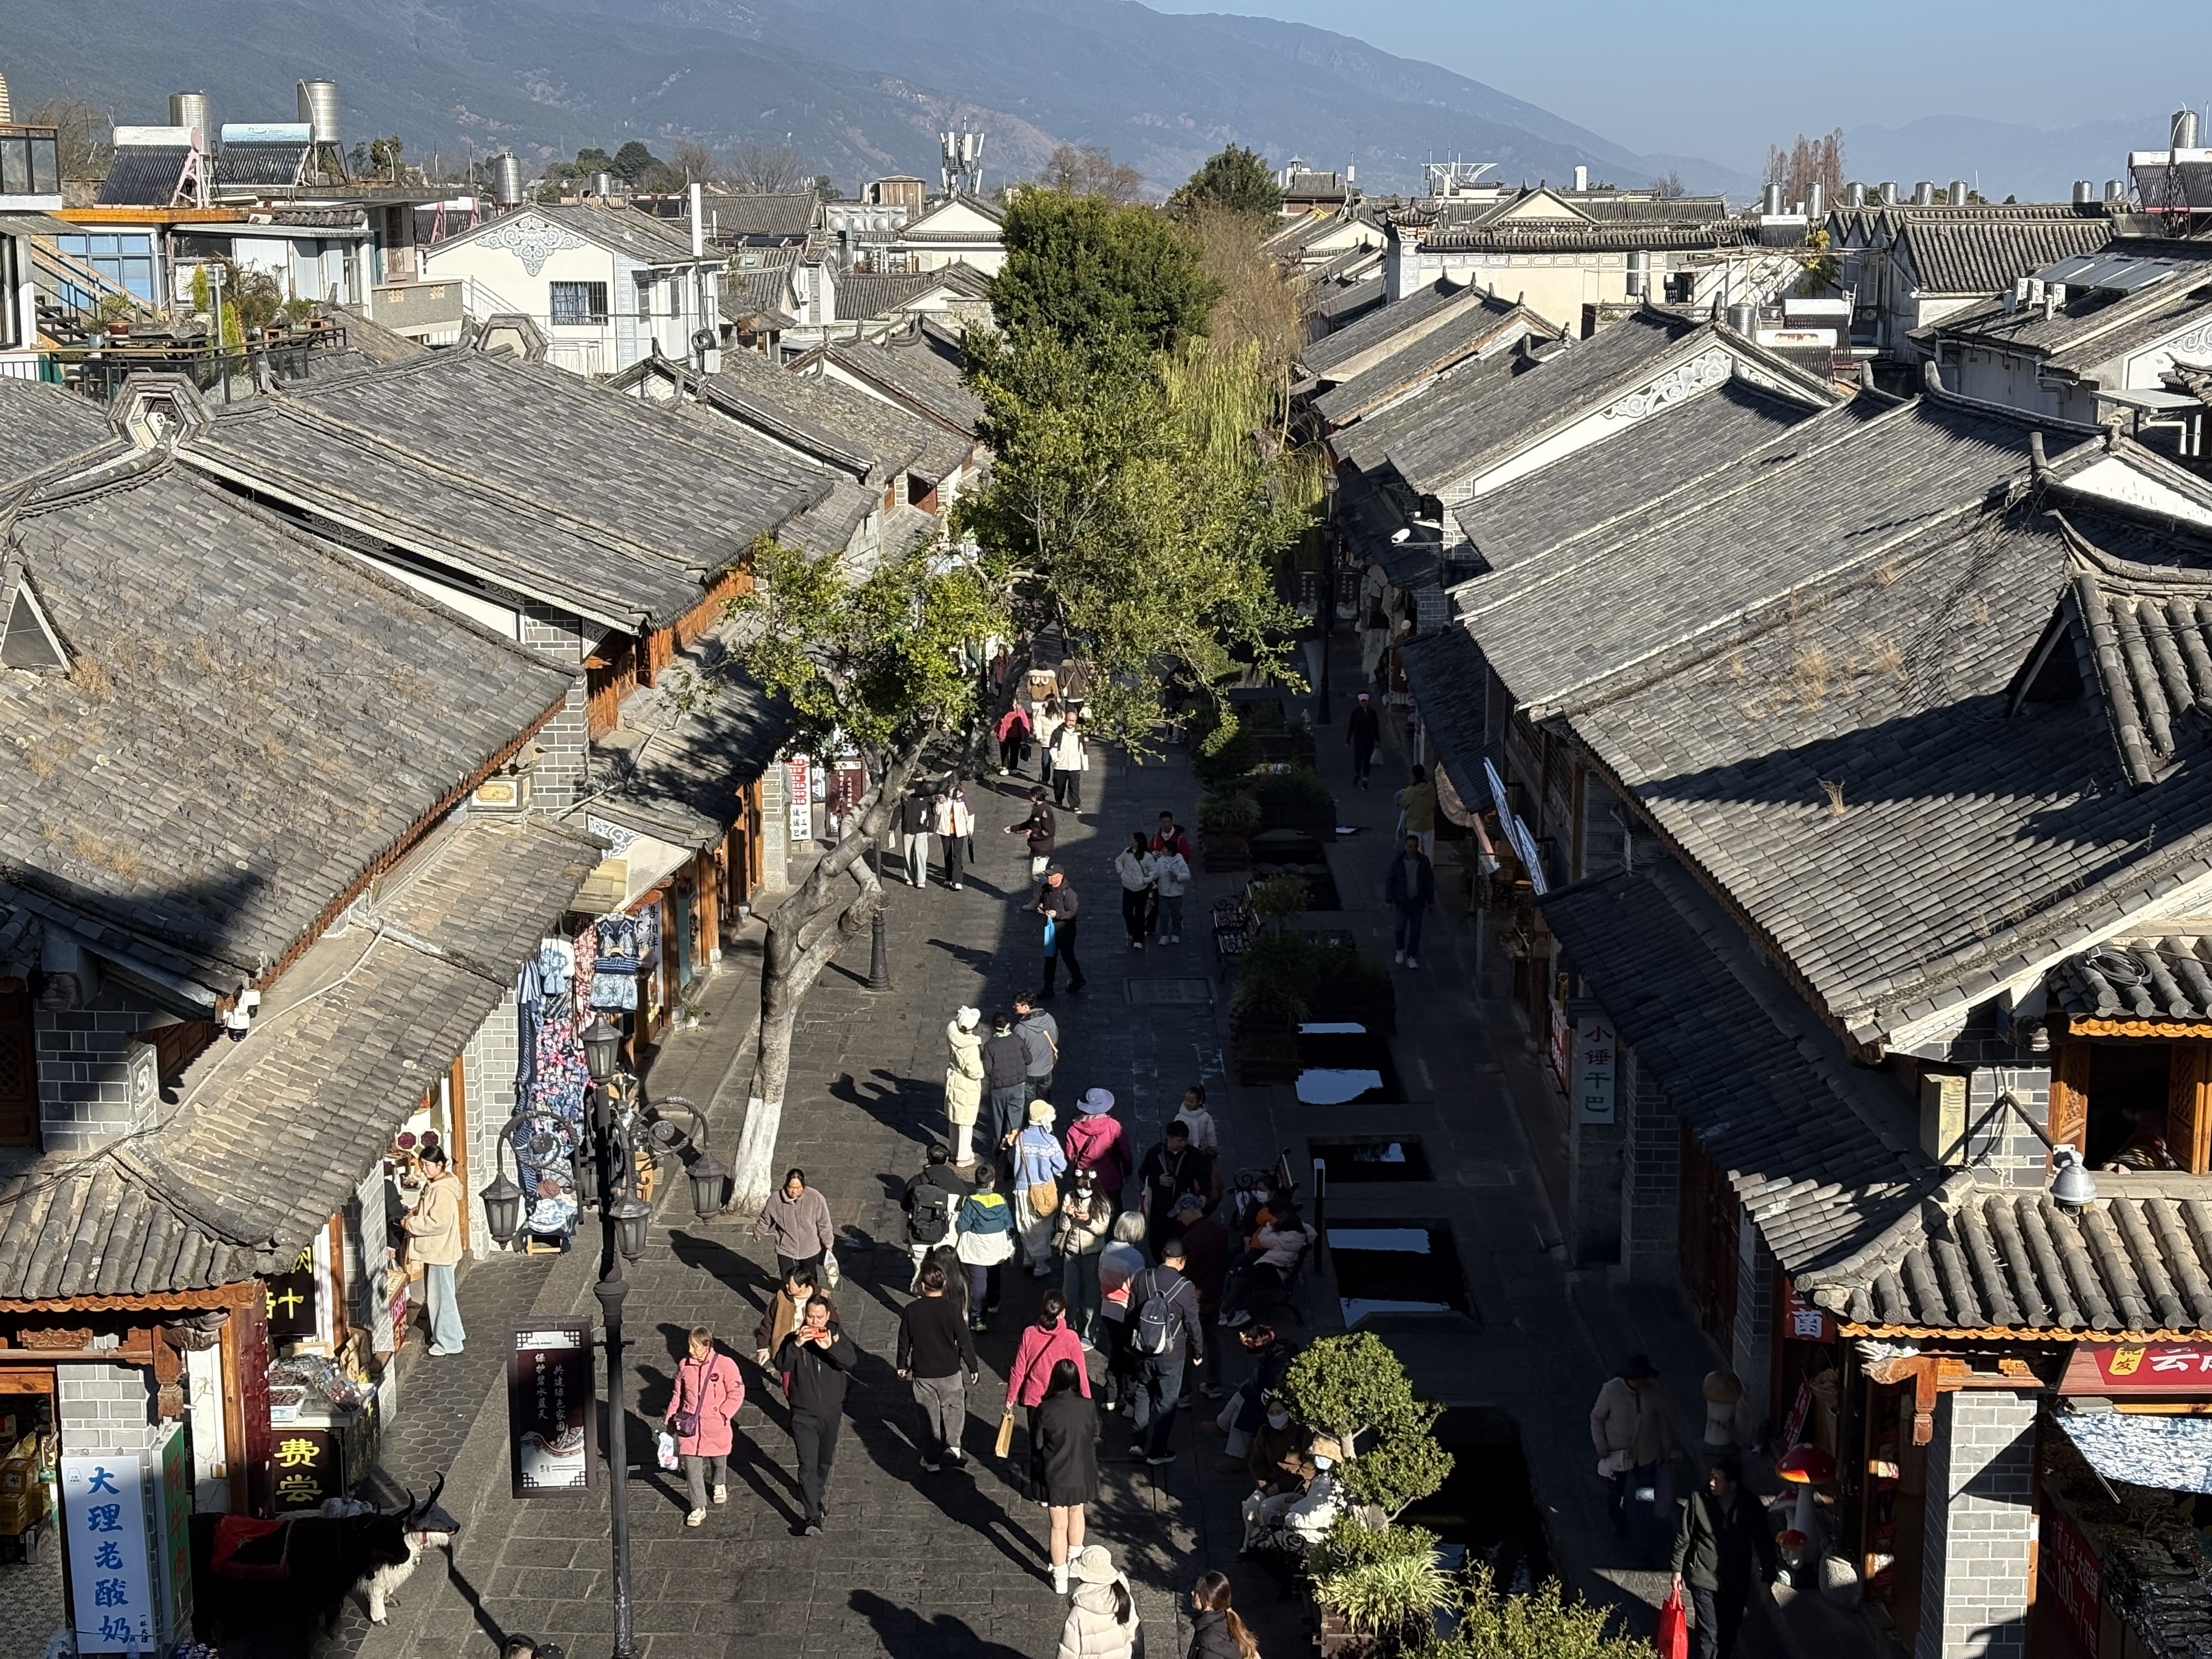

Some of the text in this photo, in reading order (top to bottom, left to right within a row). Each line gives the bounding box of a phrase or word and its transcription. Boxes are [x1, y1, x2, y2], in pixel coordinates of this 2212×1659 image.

[1584, 1025, 1613, 1113] 小锤干巴
[535, 1353, 549, 1419] 保护碧水蓝天
[2114, 1344, 2141, 1371] 批发
[2148, 1347, 2212, 1373] 云
[553, 1364, 566, 1431] 共建绿色家园
[87, 1466, 132, 1644] 大理老酸奶
[166, 1452, 188, 1591] 牦牛肉
